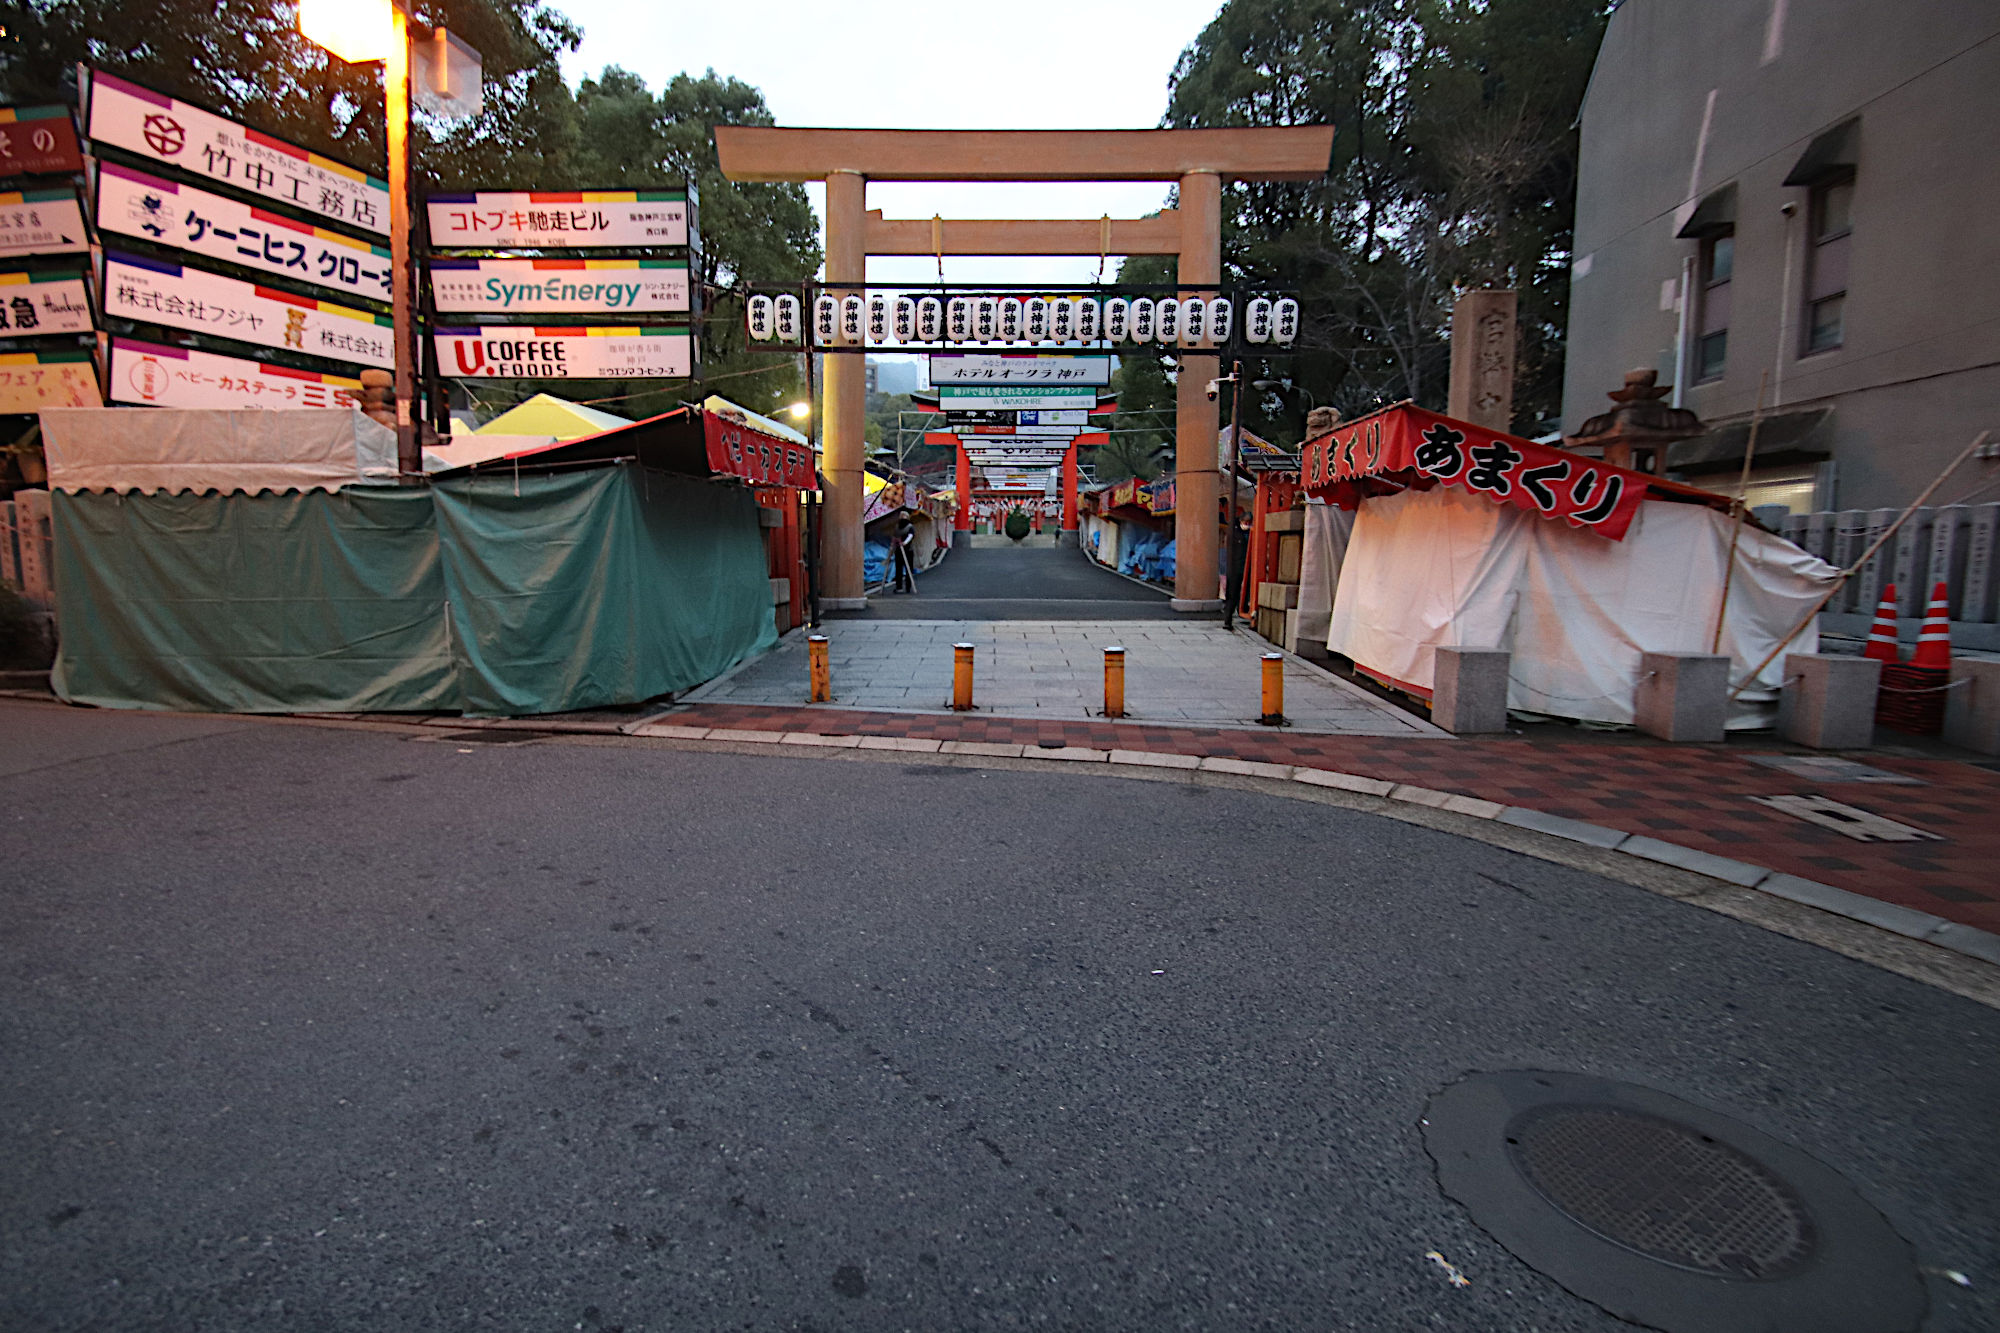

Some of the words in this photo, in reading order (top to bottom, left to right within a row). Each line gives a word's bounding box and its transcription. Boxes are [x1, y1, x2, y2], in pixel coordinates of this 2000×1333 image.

[202, 143, 378, 228] 竹中工務店
[450, 209, 610, 231] コトブキ馳走ビル
[117, 284, 263, 330] 株式会社フジヤ
[486, 278, 641, 307] SymEnergy
[499, 364, 568, 377] FOODS
[1415, 423, 1624, 525] あまくり
